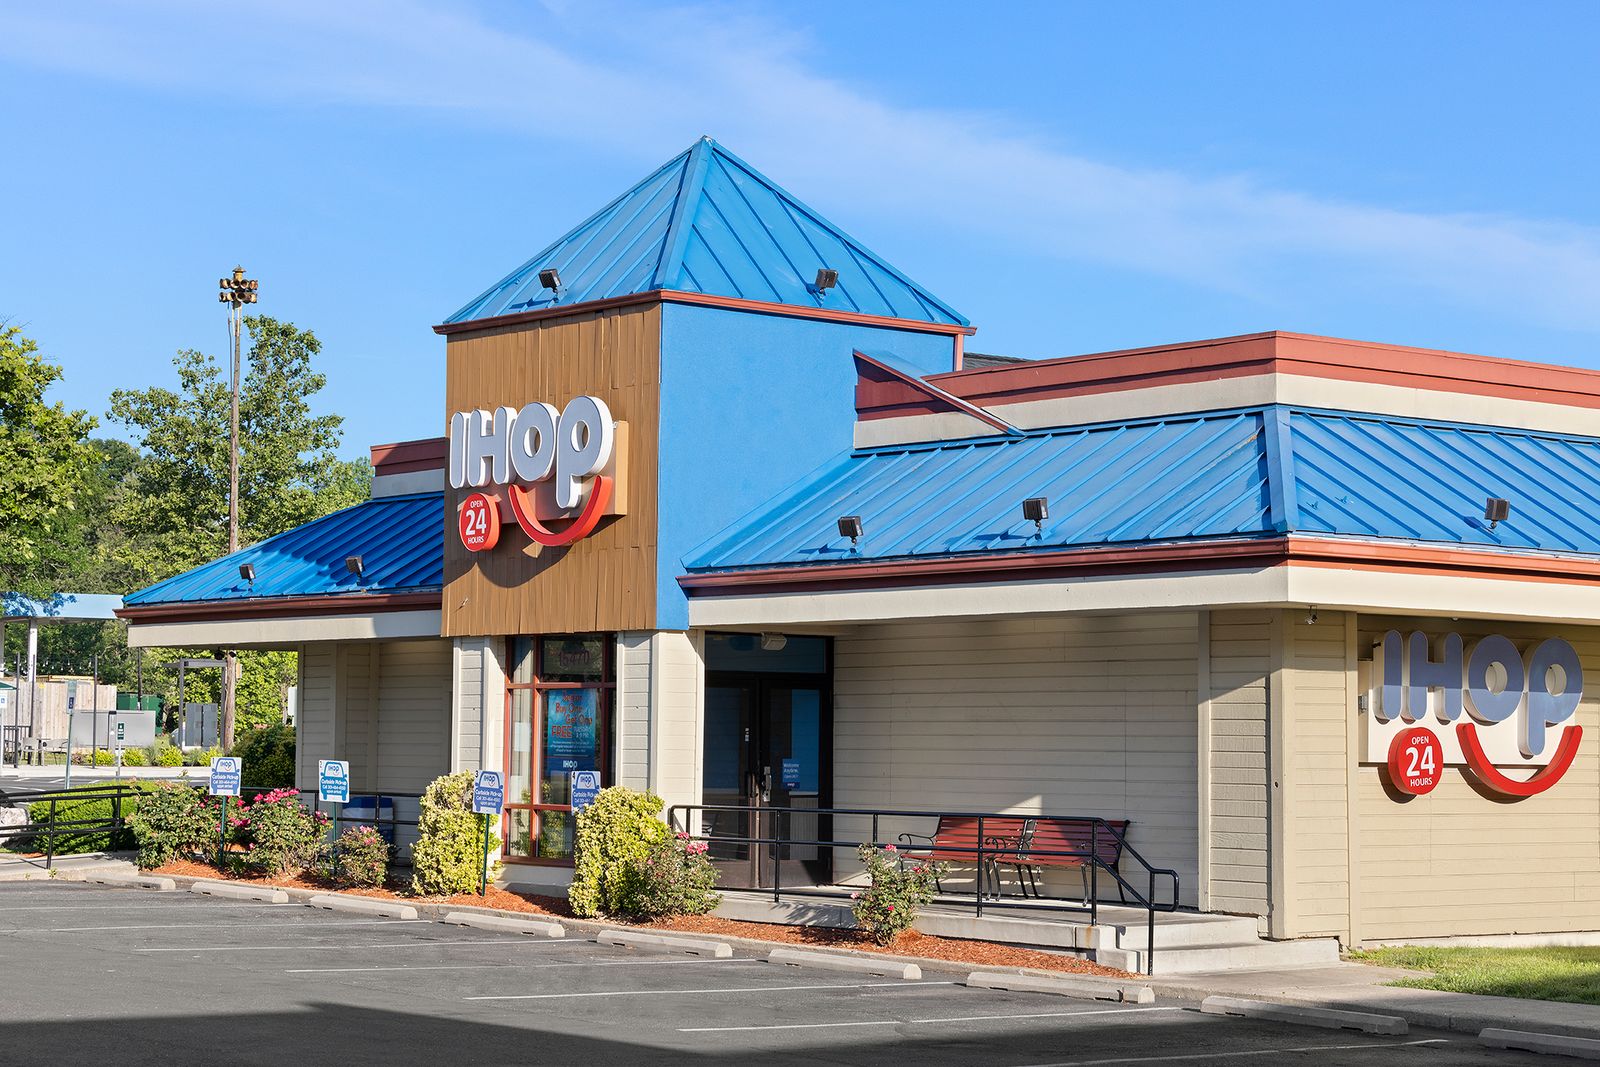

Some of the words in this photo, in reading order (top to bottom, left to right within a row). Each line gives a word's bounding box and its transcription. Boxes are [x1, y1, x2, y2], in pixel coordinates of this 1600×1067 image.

[470, 500, 484, 508] OPEN
[465, 508, 487, 536] 24
[467, 535, 485, 545] HOURS
[552, 725, 573, 738] FREE
[1411, 735, 1430, 745] OPEN
[1405, 745, 1436, 777] 24
[1410, 777, 1433, 787] HOURS
